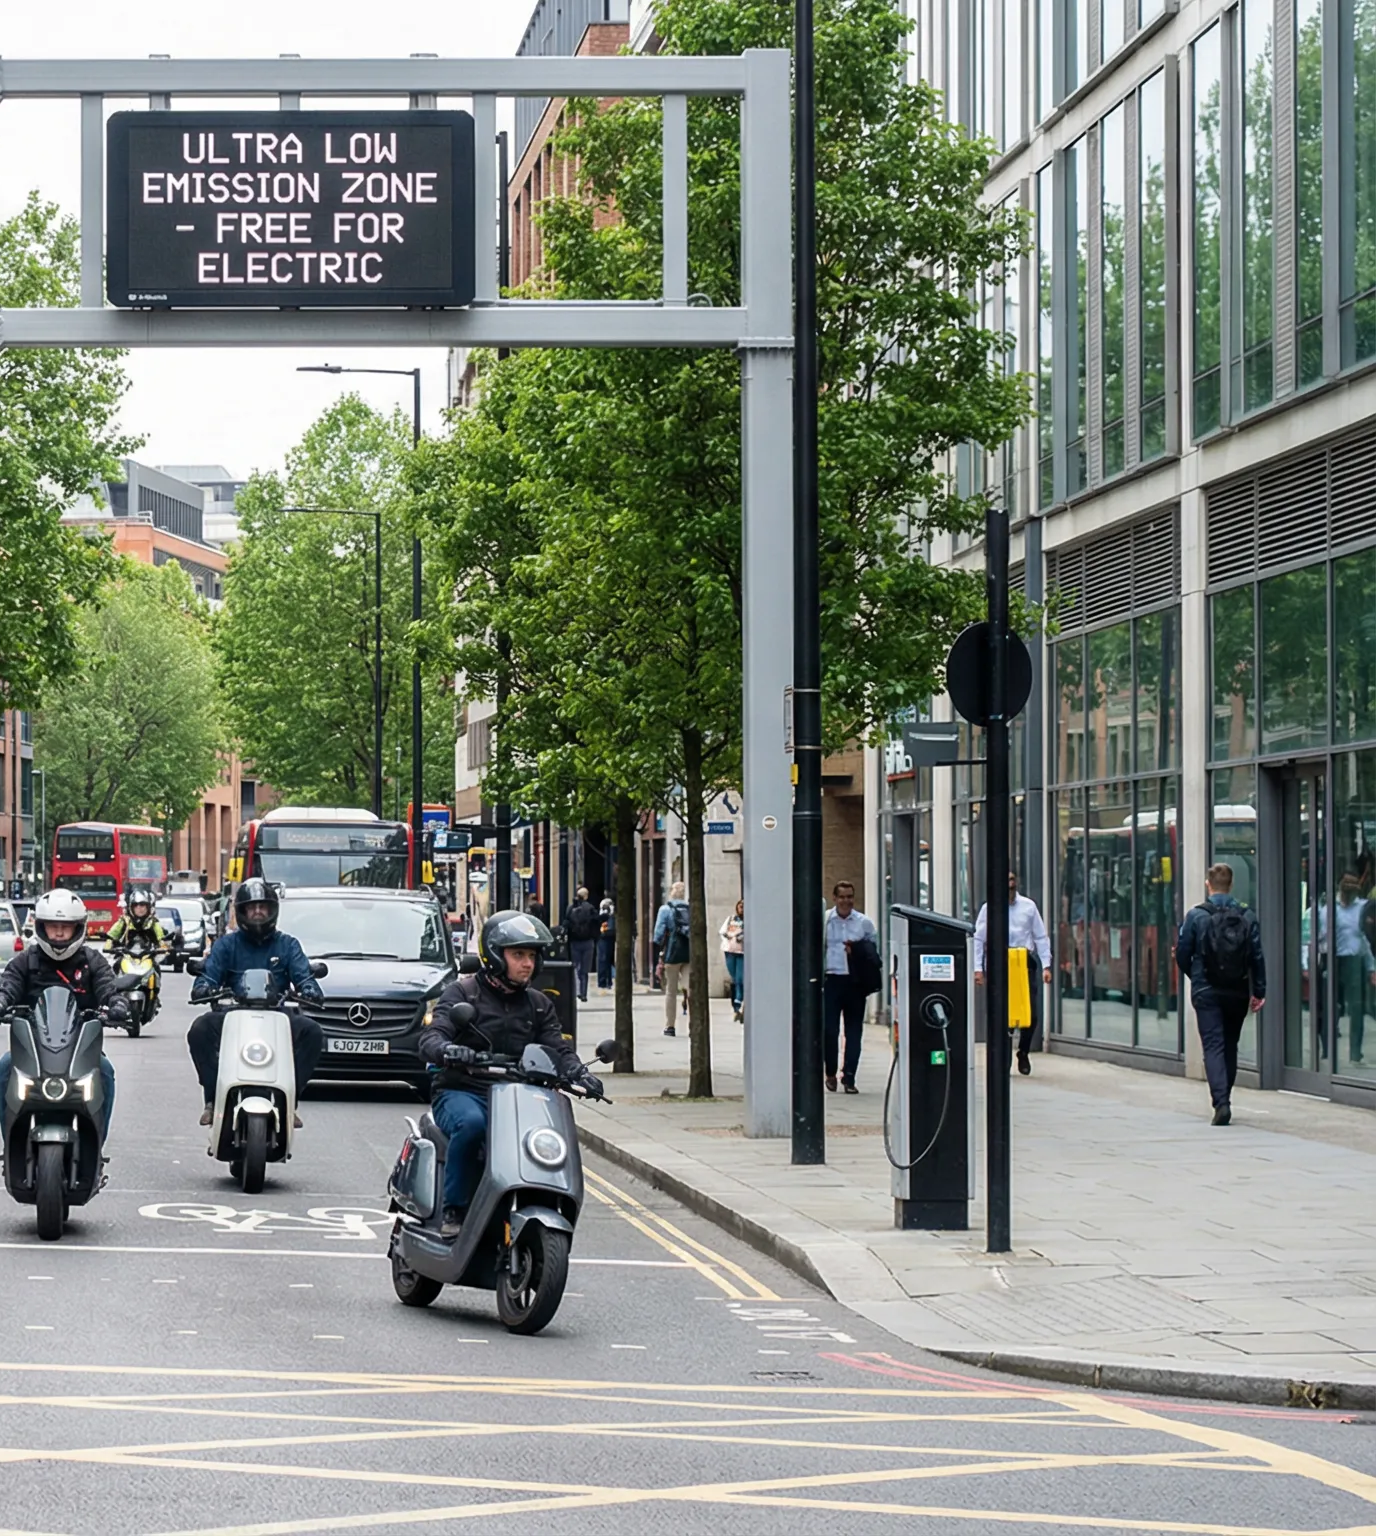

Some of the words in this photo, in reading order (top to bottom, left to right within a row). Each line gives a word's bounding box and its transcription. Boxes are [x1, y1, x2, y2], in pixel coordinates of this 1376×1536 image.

[183, 133, 302, 164] ULTRA
[325, 133, 397, 164] LOW
[143, 172, 319, 203] EMISSION
[342, 172, 437, 203] ZONE
[217, 213, 312, 243] FREE
[334, 213, 404, 243] FOR
[198, 252, 383, 283] ELECTRIC
